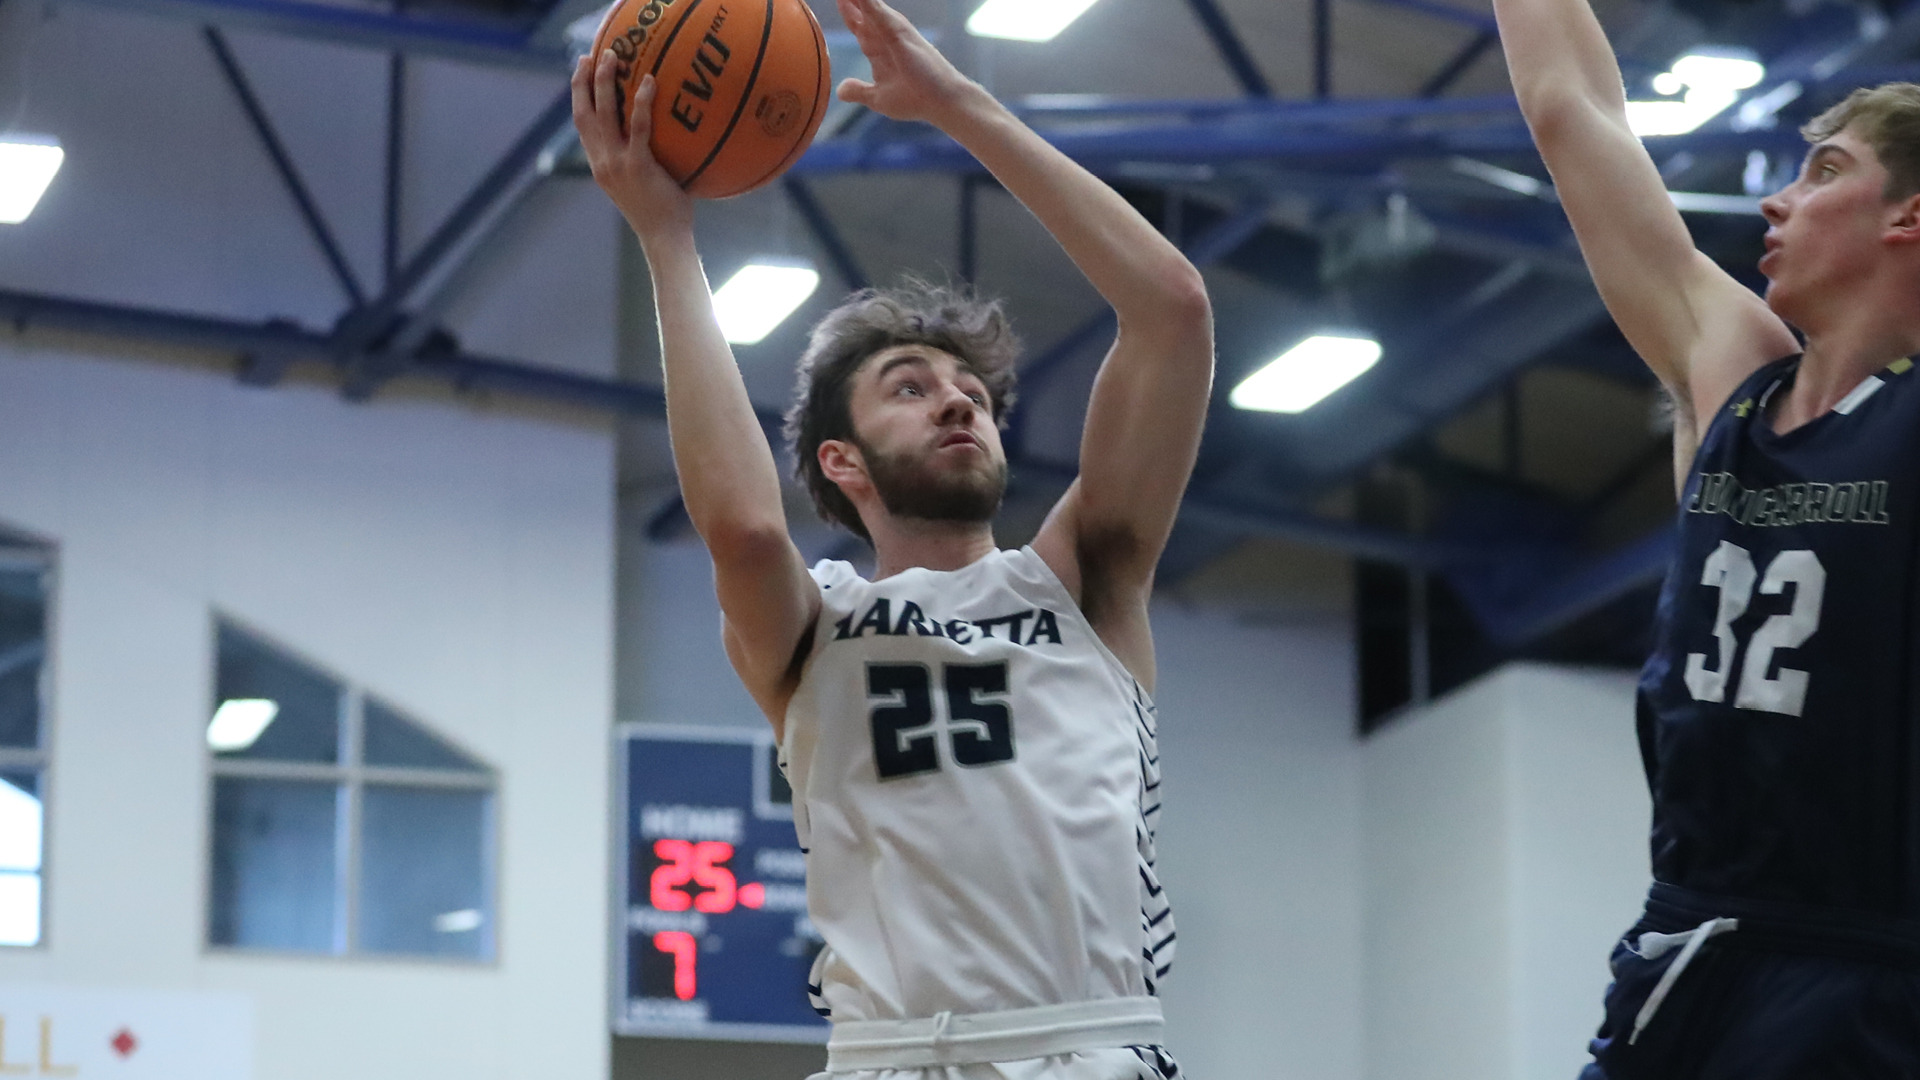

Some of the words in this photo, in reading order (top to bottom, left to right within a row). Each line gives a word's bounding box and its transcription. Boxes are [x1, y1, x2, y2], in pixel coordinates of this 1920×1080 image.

[1683, 539, 1827, 718] 32
[864, 659, 1018, 783] 25
[650, 838, 738, 914] 25
[652, 930, 697, 1002] 7
